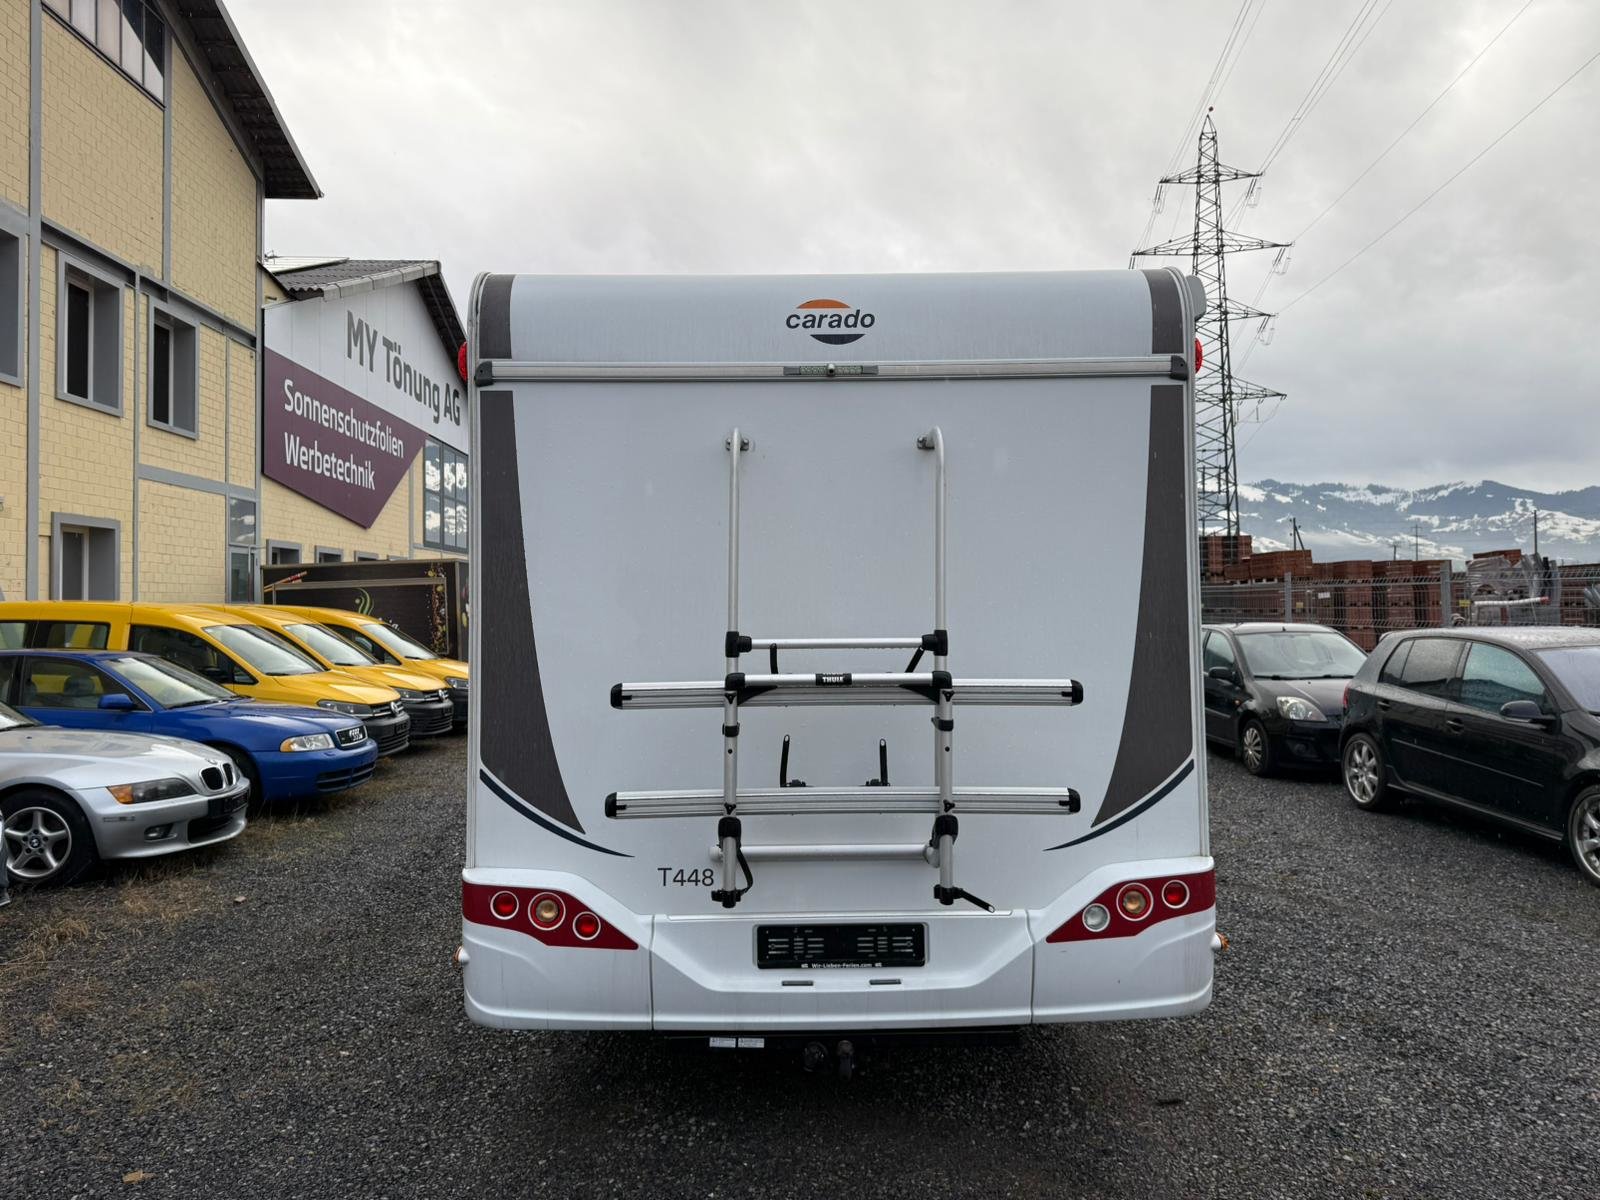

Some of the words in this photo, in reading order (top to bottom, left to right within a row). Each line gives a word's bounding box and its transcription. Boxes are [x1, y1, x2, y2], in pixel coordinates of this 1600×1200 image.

[786, 309, 875, 329] carado
[347, 310, 378, 373] MY
[382, 336, 440, 425] Tönung
[443, 383, 461, 426] AG
[284, 378, 404, 459] Sonnenschutzfolien
[284, 432, 376, 491] Werbetechnik
[822, 676, 845, 684] THULE
[657, 867, 714, 887] T448
